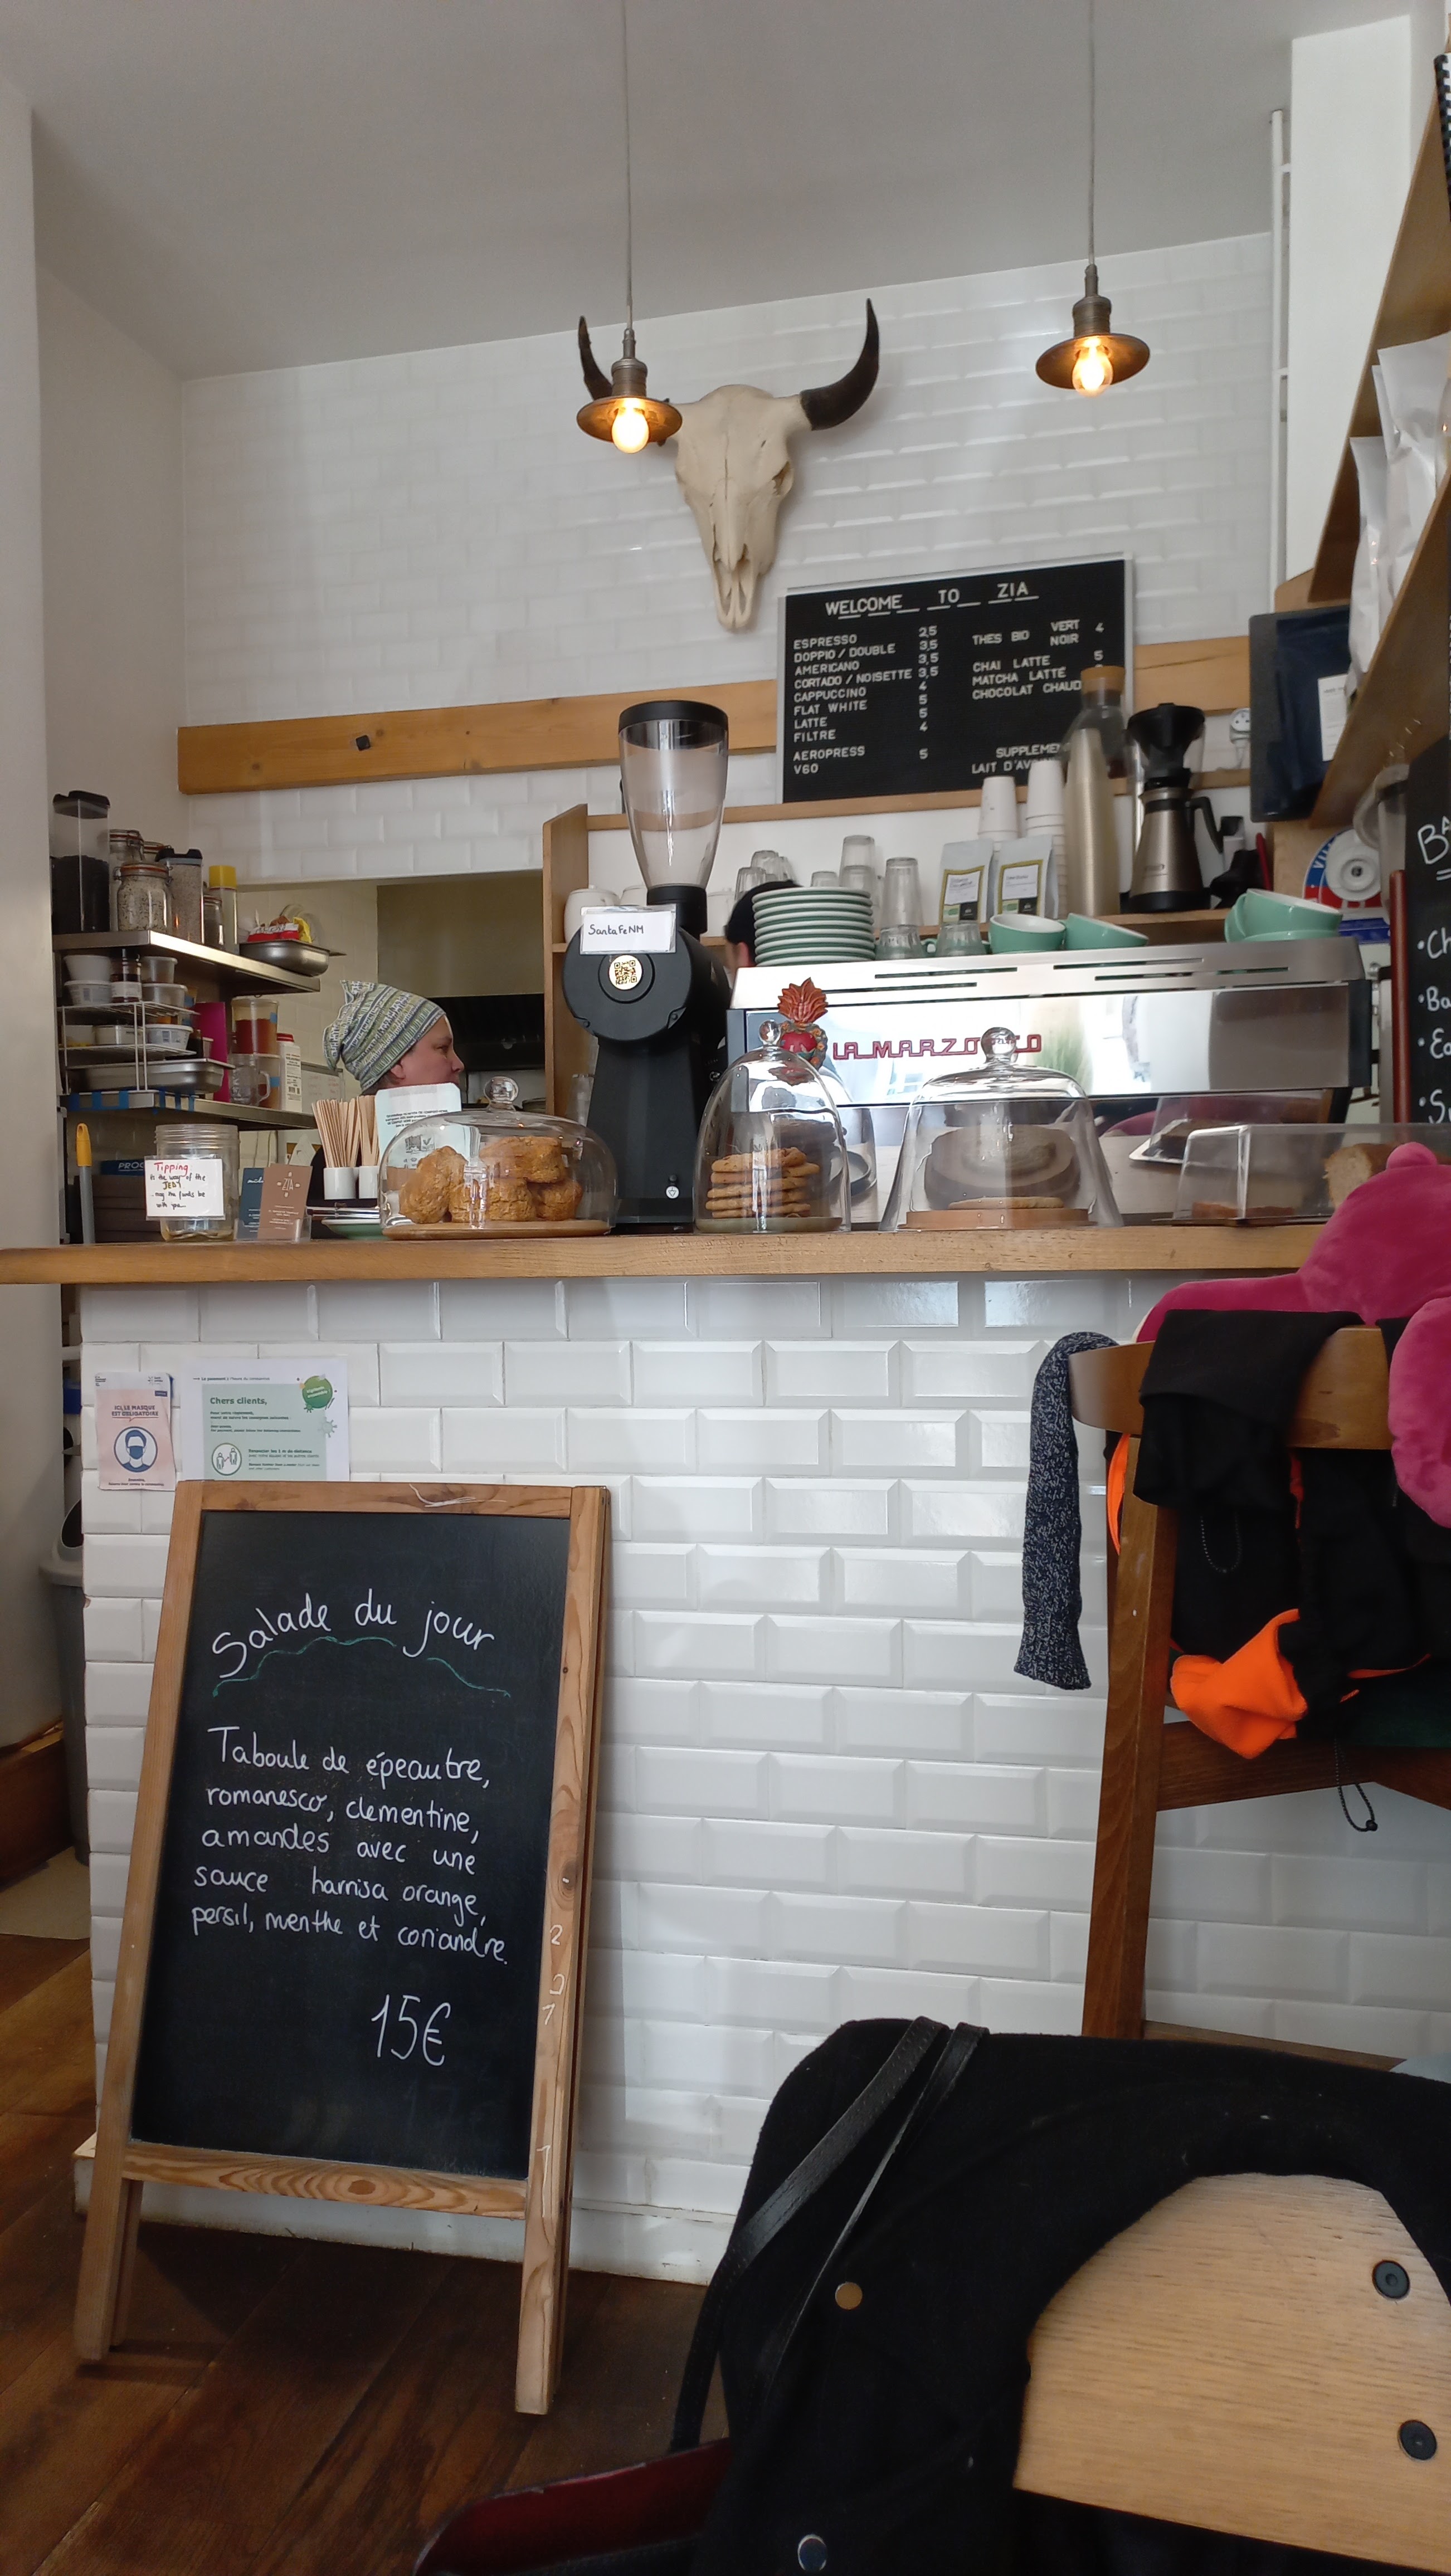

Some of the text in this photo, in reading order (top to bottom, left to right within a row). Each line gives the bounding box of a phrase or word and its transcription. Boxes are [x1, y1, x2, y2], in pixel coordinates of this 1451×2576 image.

[825, 581, 1029, 616] WELCOME TO ZIA
[1050, 619, 1104, 633] VERT 4
[793, 634, 858, 650] ESPRESSO
[972, 630, 1030, 645] THES BIO
[1050, 633, 1079, 646] NOIR
[793, 650, 836, 663] DOPPIO
[849, 643, 896, 658] DOUBLE
[919, 640, 938, 652] 3,5
[972, 650, 1103, 673] CHAI LATTE 5
[795, 652, 939, 676] AMERICANO 3,5
[794, 675, 842, 689] CORTADO
[856, 669, 913, 684] NOISETTE
[918, 666, 939, 679] 3,5
[972, 667, 1067, 686] MATCHA LATTE
[793, 681, 927, 702] CAPPUCCINO 4
[972, 680, 1082, 700] CHOCOLAT CHAUD
[793, 694, 928, 716] FLAT WHITE 5
[793, 708, 928, 729] LATTE 5
[793, 721, 928, 743] FILTRE 4
[793, 745, 928, 761] AEROPRESS 5
[793, 763, 819, 774] V60
[972, 761, 997, 774] LAIT
[588, 924, 644, 935] Santa Fe NM
[873, 1034, 1041, 1058] MARZOO
[154, 1162, 188, 1177] Tipping
[186, 1173, 192, 1181] of
[237, 1397, 267, 1406] clients,
[212, 1588, 495, 1679] Salade du jour
[207, 1726, 490, 1790] Taboule de épeautre,
[206, 1786, 479, 1845] romanesco, clementine,
[202, 1823, 476, 1875] amandes avec une
[194, 1865, 269, 1893] sauce
[402, 1884, 486, 1928] orange,
[192, 1902, 508, 1965] persil, menthe et coriandre.
[371, 1994, 451, 2066] 15€
